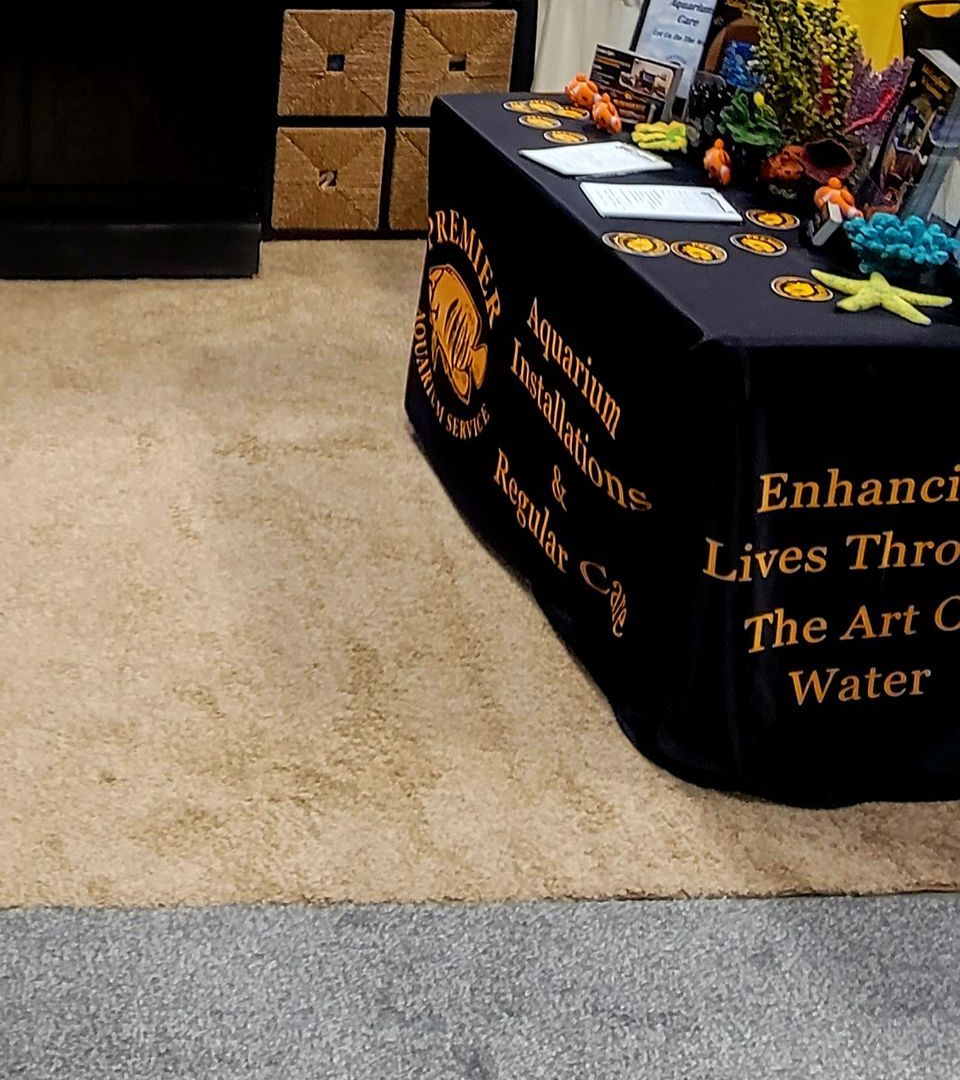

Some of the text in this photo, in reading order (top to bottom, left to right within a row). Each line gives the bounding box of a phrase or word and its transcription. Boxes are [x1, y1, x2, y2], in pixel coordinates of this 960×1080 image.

[529, 297, 622, 440] Aquarium
[445, 403, 491, 441] SERVICE
[511, 338, 652, 512] Installations
[551, 464, 568, 512] &
[493, 448, 627, 638] Regular Care
[702, 537, 828, 583] Lives
[744, 608, 828, 653] The
[839, 603, 921, 640] Art
[788, 667, 931, 706] Water
